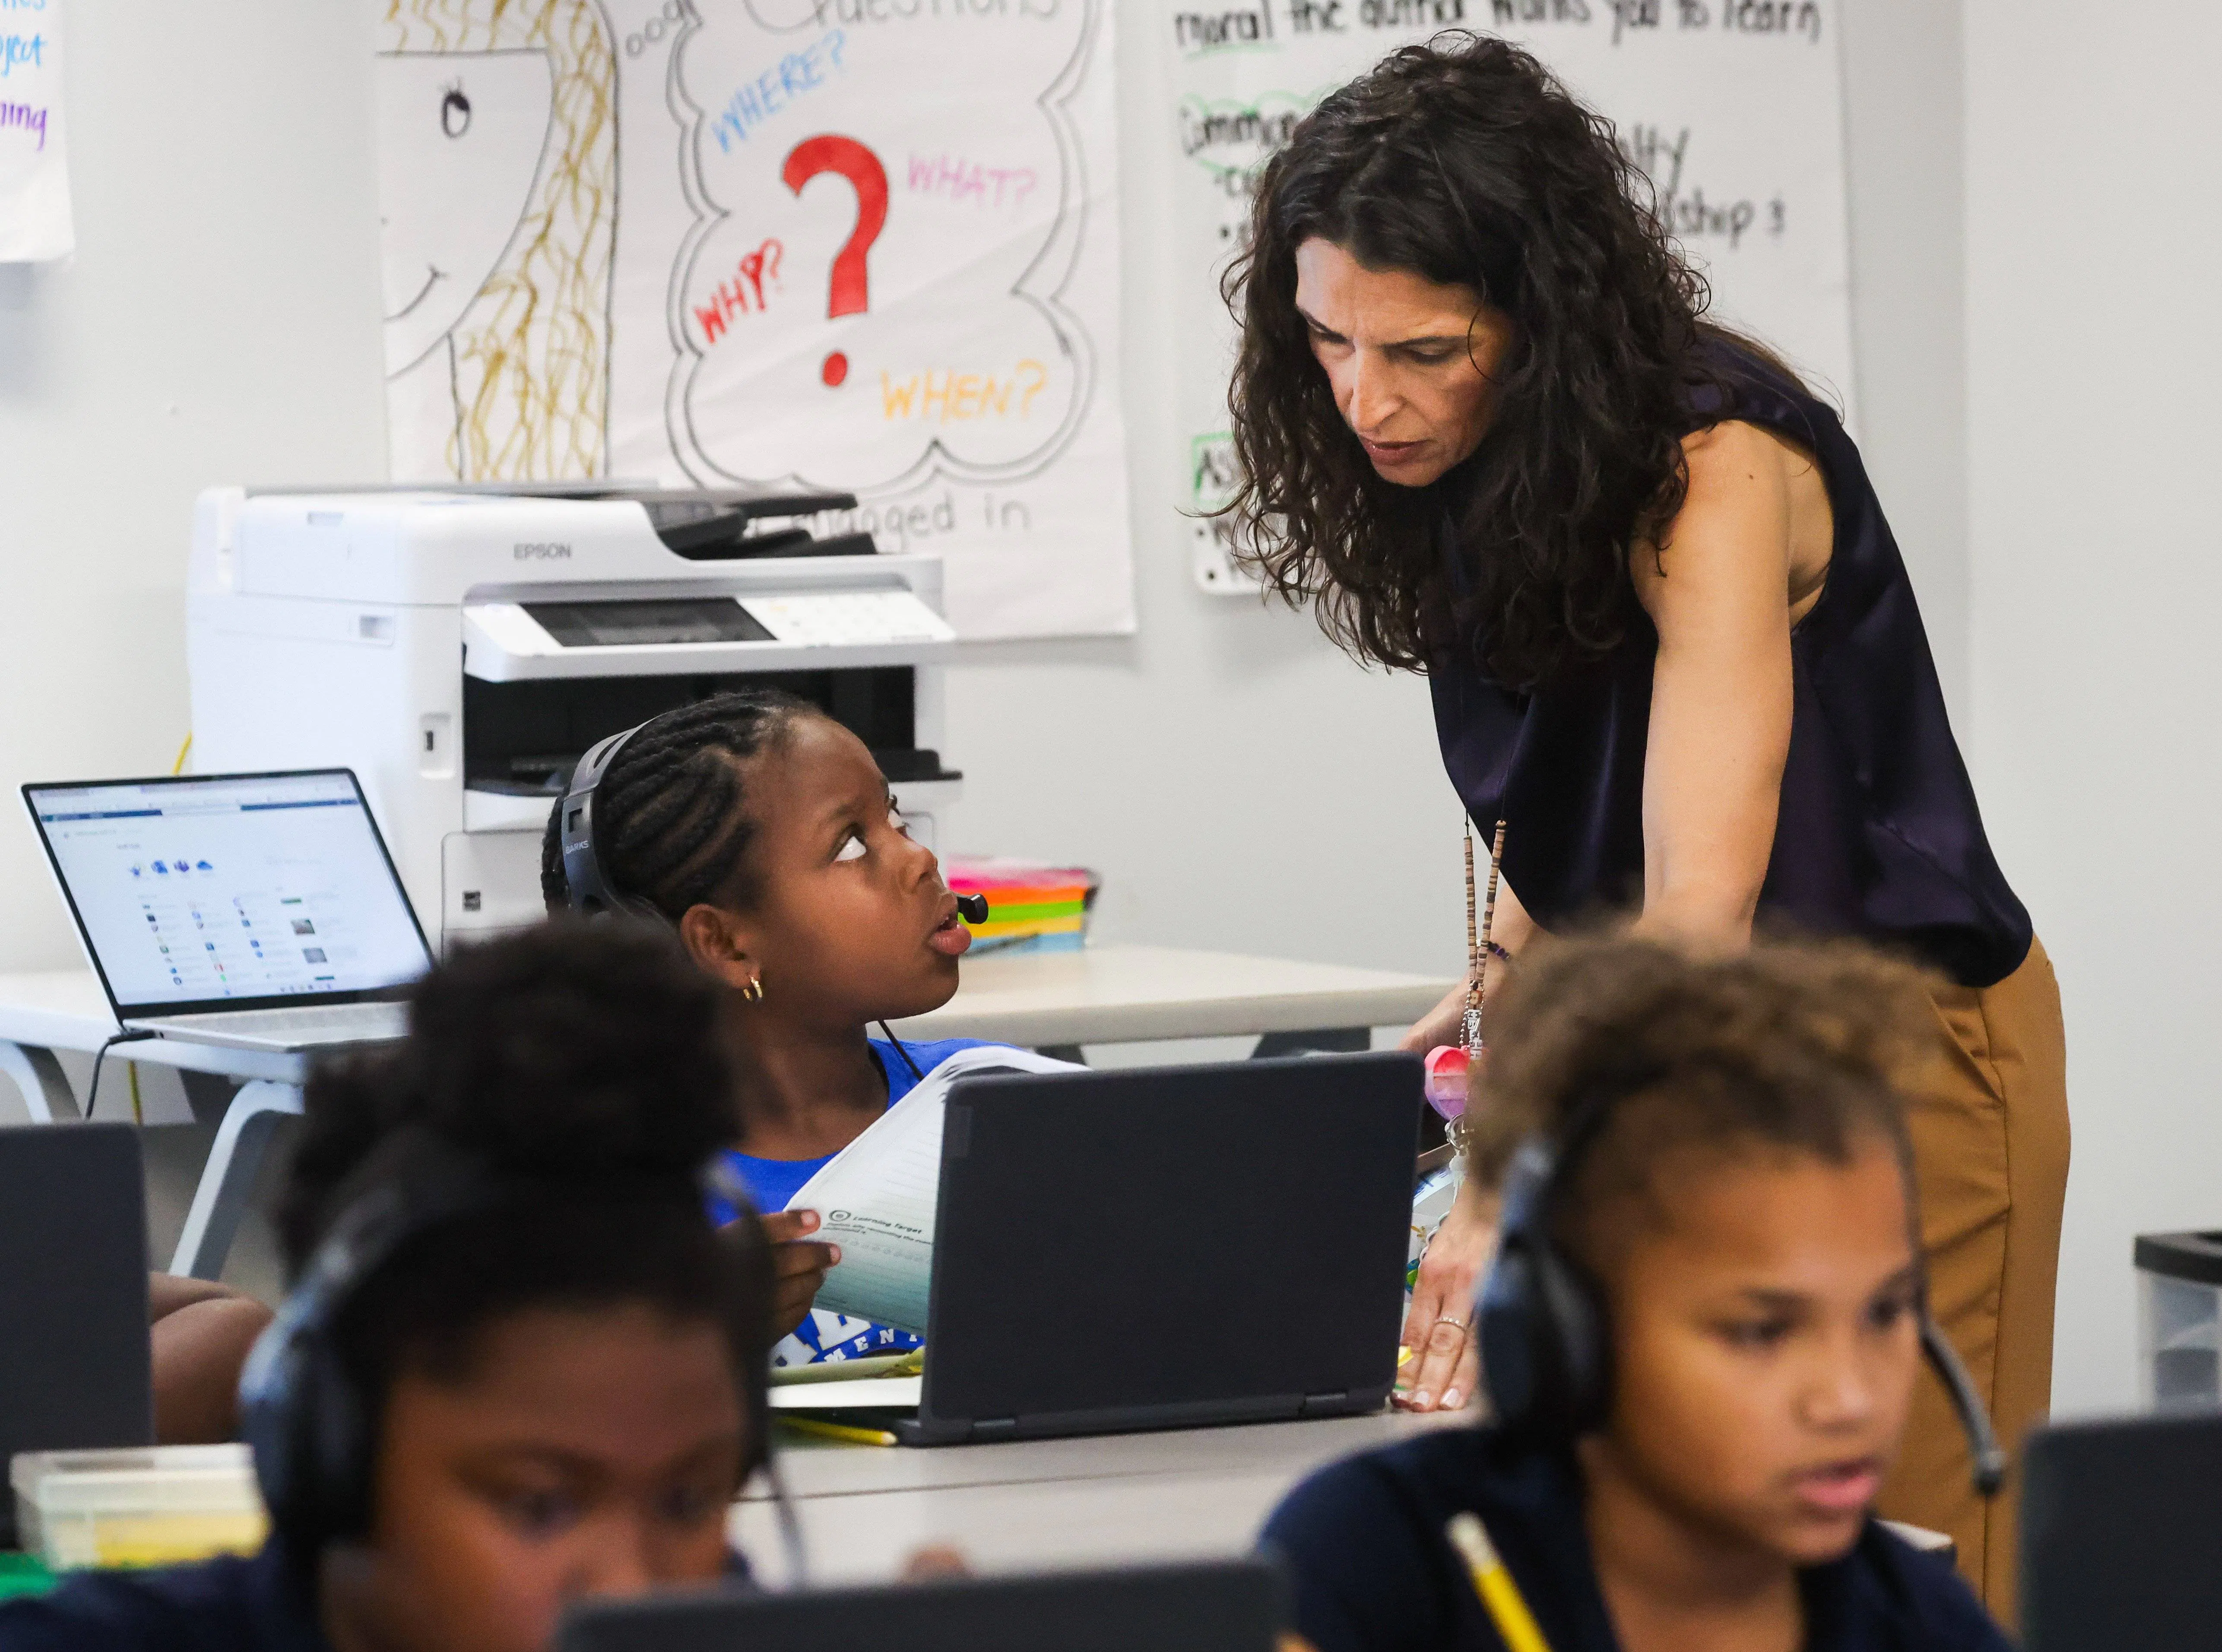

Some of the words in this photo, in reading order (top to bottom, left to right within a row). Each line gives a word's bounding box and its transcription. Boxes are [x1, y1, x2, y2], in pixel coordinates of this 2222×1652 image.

[710, 29, 847, 154] WHERE?
[908, 152, 1037, 207] WHAT?
[694, 238, 786, 345] WHY?
[880, 358, 1049, 422] WHEN?
[985, 492, 1032, 529] in
[514, 543, 571, 560] EPSON
[853, 1217, 892, 1227] Learning
[895, 1223, 922, 1234] Target
